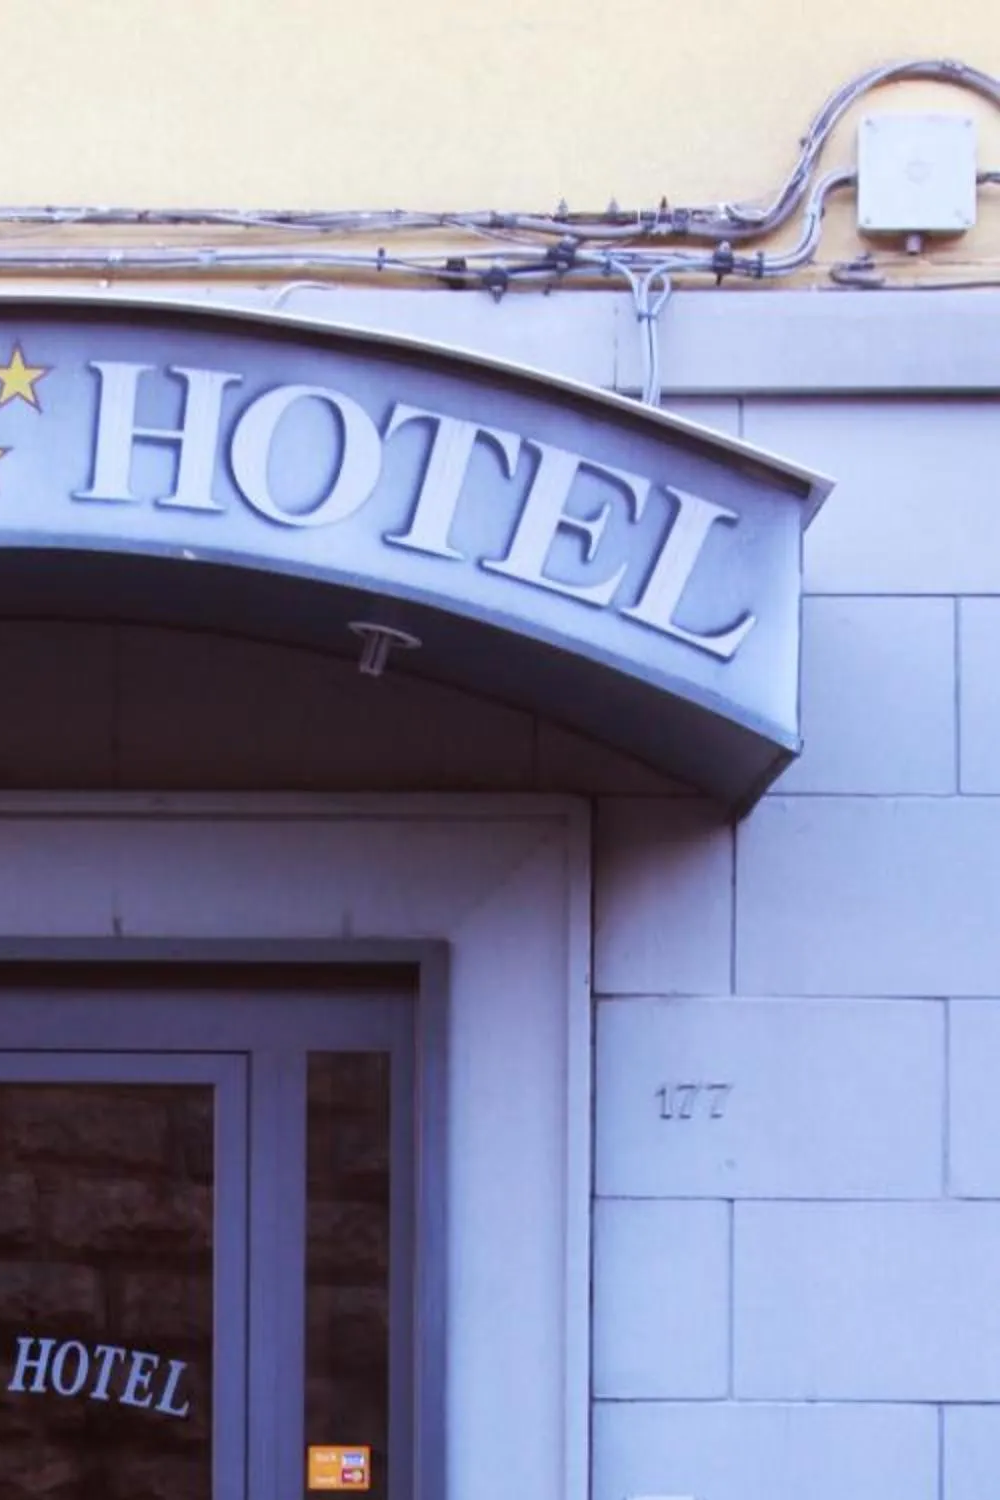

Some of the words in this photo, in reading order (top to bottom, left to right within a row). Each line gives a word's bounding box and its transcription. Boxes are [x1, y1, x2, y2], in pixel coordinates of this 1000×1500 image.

[70, 361, 756, 662] HOTEL
[654, 1083, 734, 1119] 177
[8, 1337, 190, 1417] HOTEL
